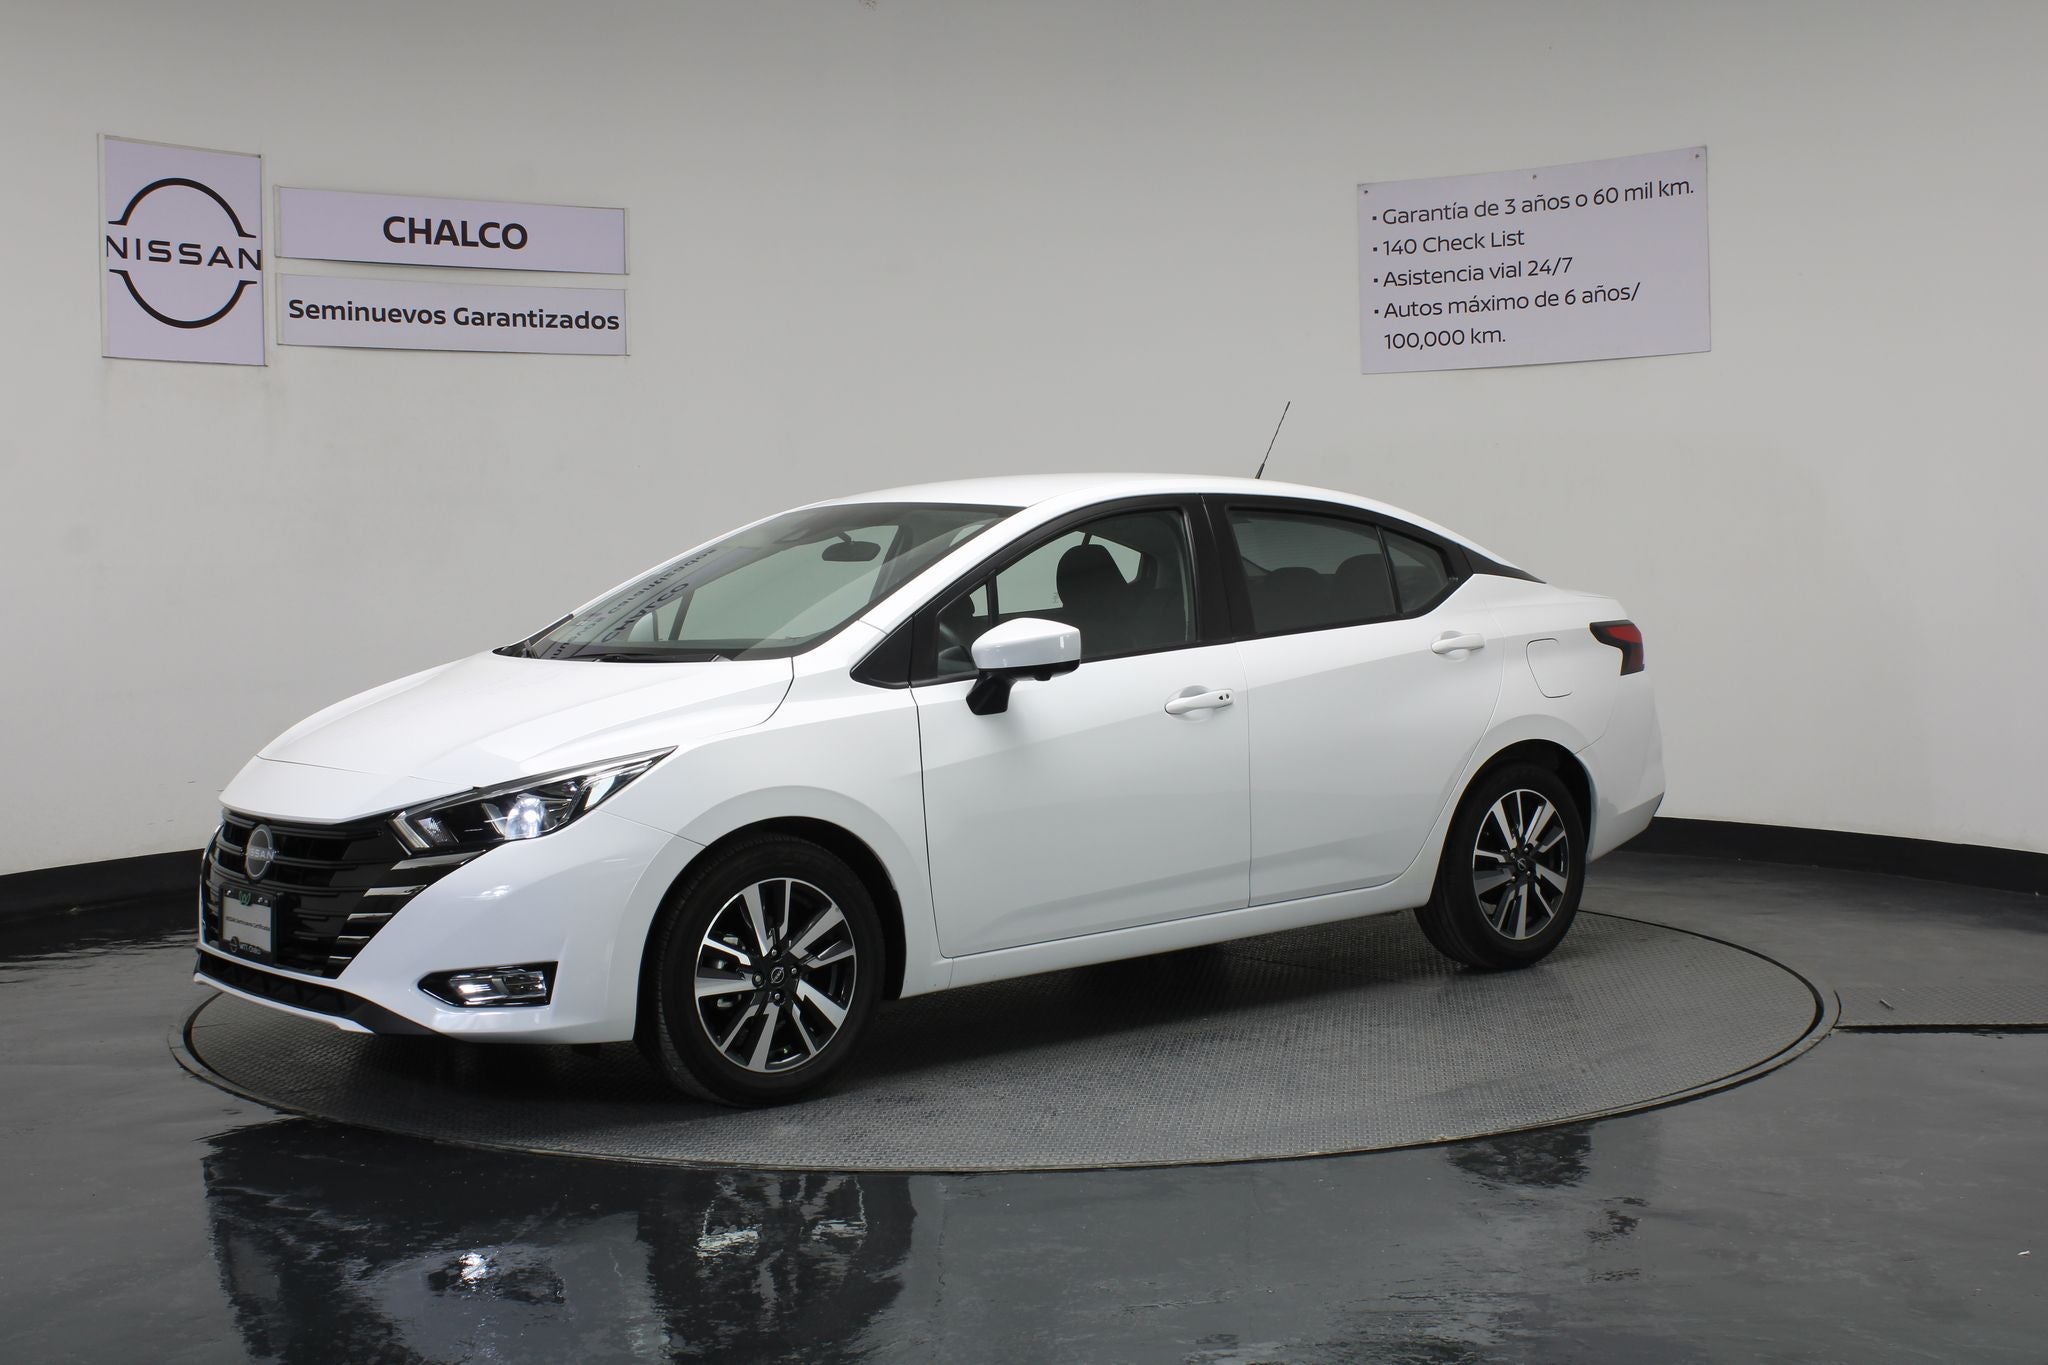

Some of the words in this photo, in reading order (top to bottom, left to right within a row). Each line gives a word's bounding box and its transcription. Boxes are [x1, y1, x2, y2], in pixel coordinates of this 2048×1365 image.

[1382, 201, 1470, 225] Garantía
[1473, 200, 1500, 218] de
[1504, 198, 1516, 216] 3
[1521, 194, 1571, 214] años
[1575, 193, 1588, 208] o
[1593, 186, 1619, 206] 60
[1624, 181, 1653, 202] mil
[1658, 180, 1695, 198] km.
[382, 215, 528, 250] CHALCO
[1382, 238, 1418, 256] 140
[1422, 232, 1486, 253] Check
[1491, 229, 1525, 248] List
[106, 234, 262, 272] NISSAN
[1383, 264, 1484, 288] Asistencia
[1488, 260, 1522, 280] vial
[1527, 256, 1574, 278] 24/7
[288, 299, 448, 325] Seminuevos
[453, 307, 621, 331] Garantizados
[1383, 301, 1443, 319] Autos
[1448, 294, 1530, 315] máximo
[1534, 290, 1560, 308] de
[1564, 288, 1577, 306] 6
[1581, 281, 1641, 304] años/
[1384, 329, 1465, 351] 100,000
[1470, 327, 1506, 346] km.
